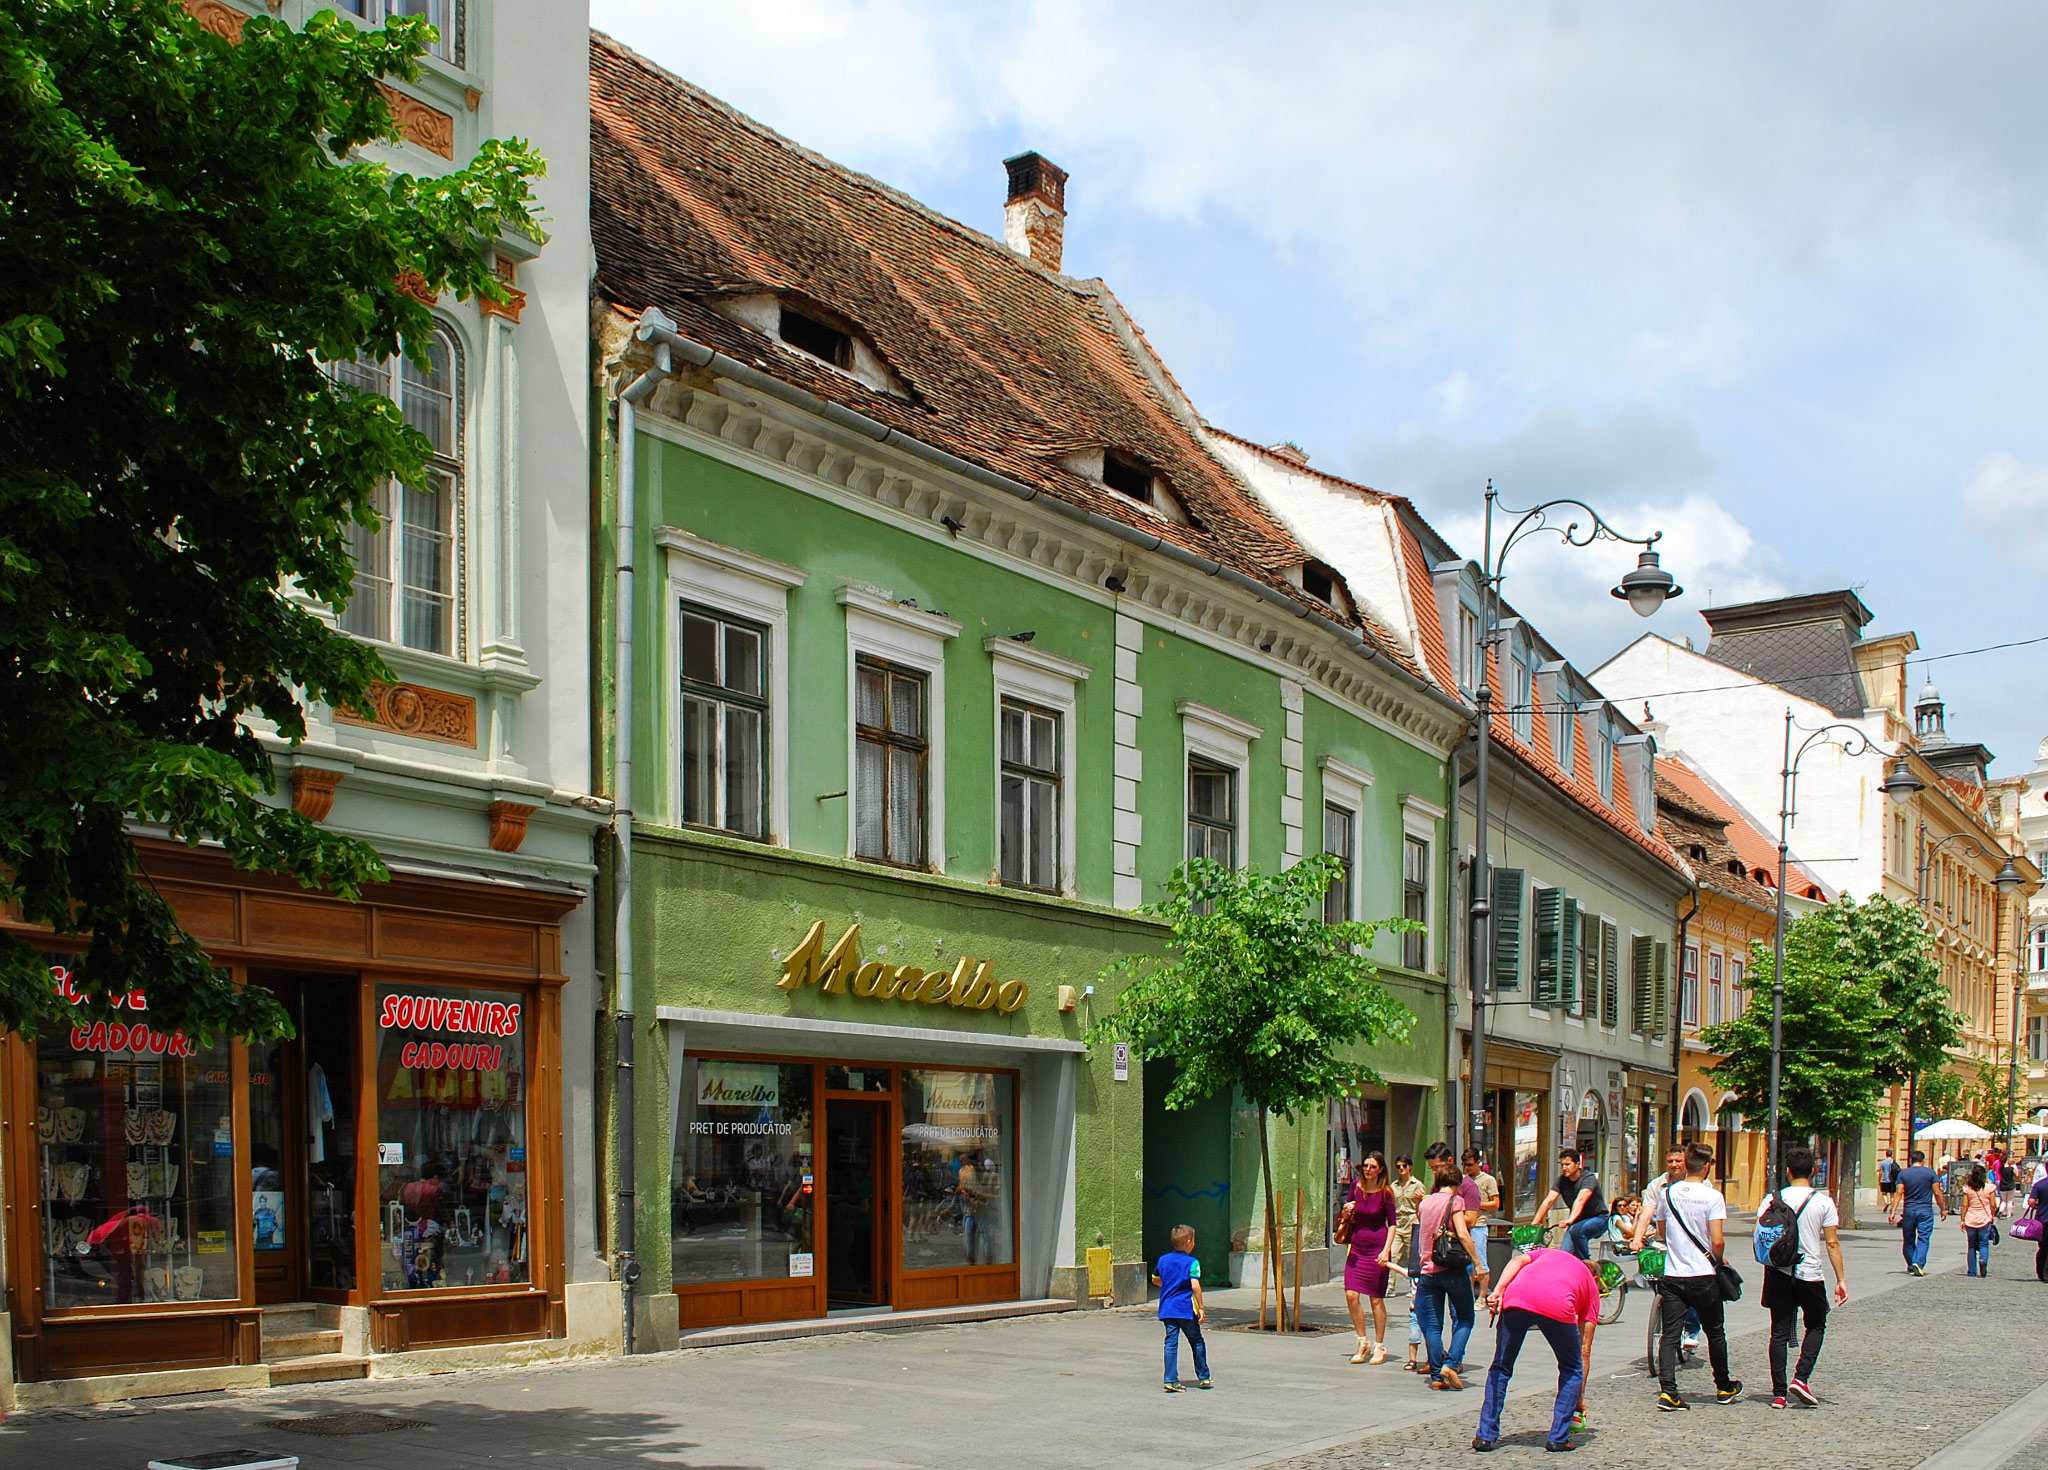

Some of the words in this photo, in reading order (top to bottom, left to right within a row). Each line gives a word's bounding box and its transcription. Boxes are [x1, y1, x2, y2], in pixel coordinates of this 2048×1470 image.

[775, 920, 1029, 1012] Marelbo
[380, 994, 521, 1037] SOUVENIRS
[401, 1042, 501, 1072] CADOURI
[701, 1078, 776, 1102] Marelbo
[926, 1087, 985, 1110] Marelbo
[689, 1122, 714, 1135] PRET
[716, 1122, 729, 1135] DE
[731, 1120, 792, 1136] PRODUCĂTOR
[951, 1126, 999, 1138] PRODUCĂTOR
